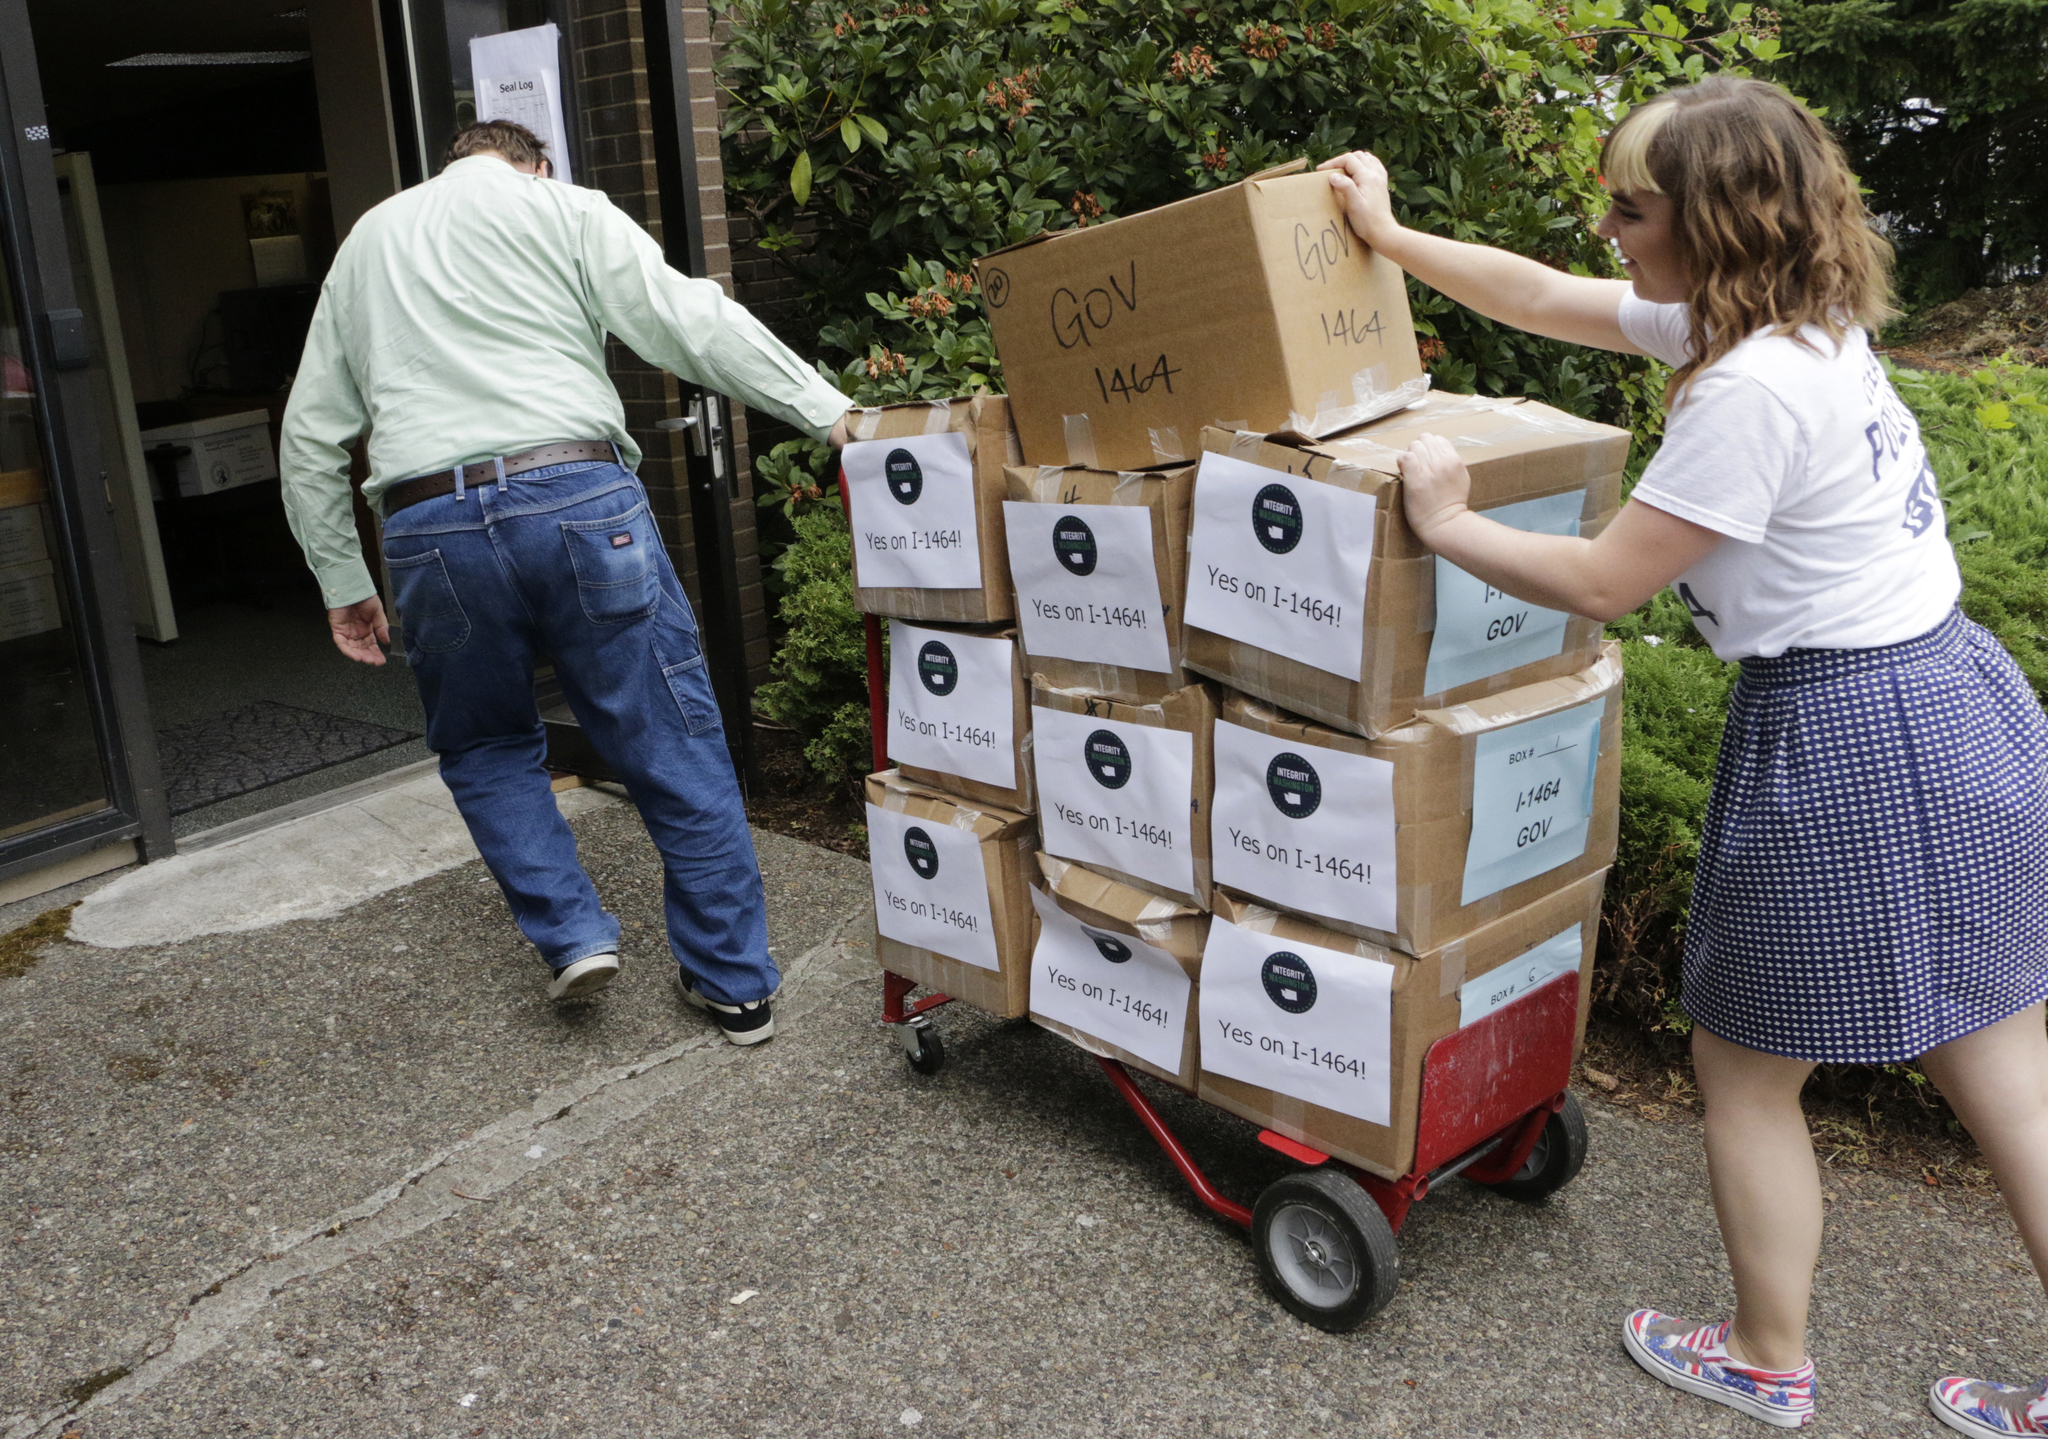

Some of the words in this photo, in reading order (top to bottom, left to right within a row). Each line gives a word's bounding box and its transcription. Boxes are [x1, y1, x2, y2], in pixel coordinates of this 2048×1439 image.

[500, 83, 517, 93] Seal
[518, 81, 534, 91] Log
[1051, 260, 1136, 349] GOV
[1321, 308, 1387, 348] 1464
[1095, 353, 1183, 404] 1464
[890, 462, 913, 472] INTEGRITY
[1259, 508, 1296, 528] WASHINGTON
[1263, 498, 1293, 516] INTEGRITY
[864, 532, 888, 550] Yes
[891, 535, 907, 550] on
[912, 529, 962, 550] I-1464!
[1060, 530, 1087, 541] INTEGRITY
[1206, 564, 1239, 593] Yes
[1244, 582, 1266, 603] on
[1273, 585, 1342, 628] I-1464!
[1032, 598, 1061, 619] Yes
[1065, 605, 1084, 622] on
[1088, 604, 1147, 629] I-1464!
[1486, 610, 1529, 642] GOV
[924, 653, 950, 665] INTEGRITY
[898, 708, 916, 732] Yes
[919, 721, 937, 737] on
[942, 721, 996, 749] I-1464!
[1092, 743, 1121, 756] INTEGRITY
[1508, 750, 1528, 765] BOX
[1272, 776, 1315, 794] WASHINGTON
[1276, 766, 1310, 783] INTEGRITY
[1515, 777, 1562, 813] I-1464
[1054, 802, 1084, 826] Yes
[1088, 814, 1109, 832] on
[1115, 816, 1173, 850] I-1464!
[1516, 815, 1554, 848] GOV
[1228, 826, 1261, 855] Yes
[1266, 843, 1289, 865] on
[1295, 848, 1372, 885] I-1464!
[884, 889, 907, 911] Yes
[910, 901, 927, 917] on
[930, 903, 979, 933] I-1464!
[1268, 973, 1310, 992] WASHINGTON
[1272, 964, 1306, 981] INTEGRITY
[1047, 965, 1076, 991] Yes
[1081, 983, 1104, 1001] on
[1108, 988, 1168, 1029] I-1464!
[1490, 987, 1508, 1006] BOX
[1218, 1019, 1254, 1046] Yes
[1260, 1035, 1285, 1056] on
[1292, 1040, 1366, 1081] I-1464!
